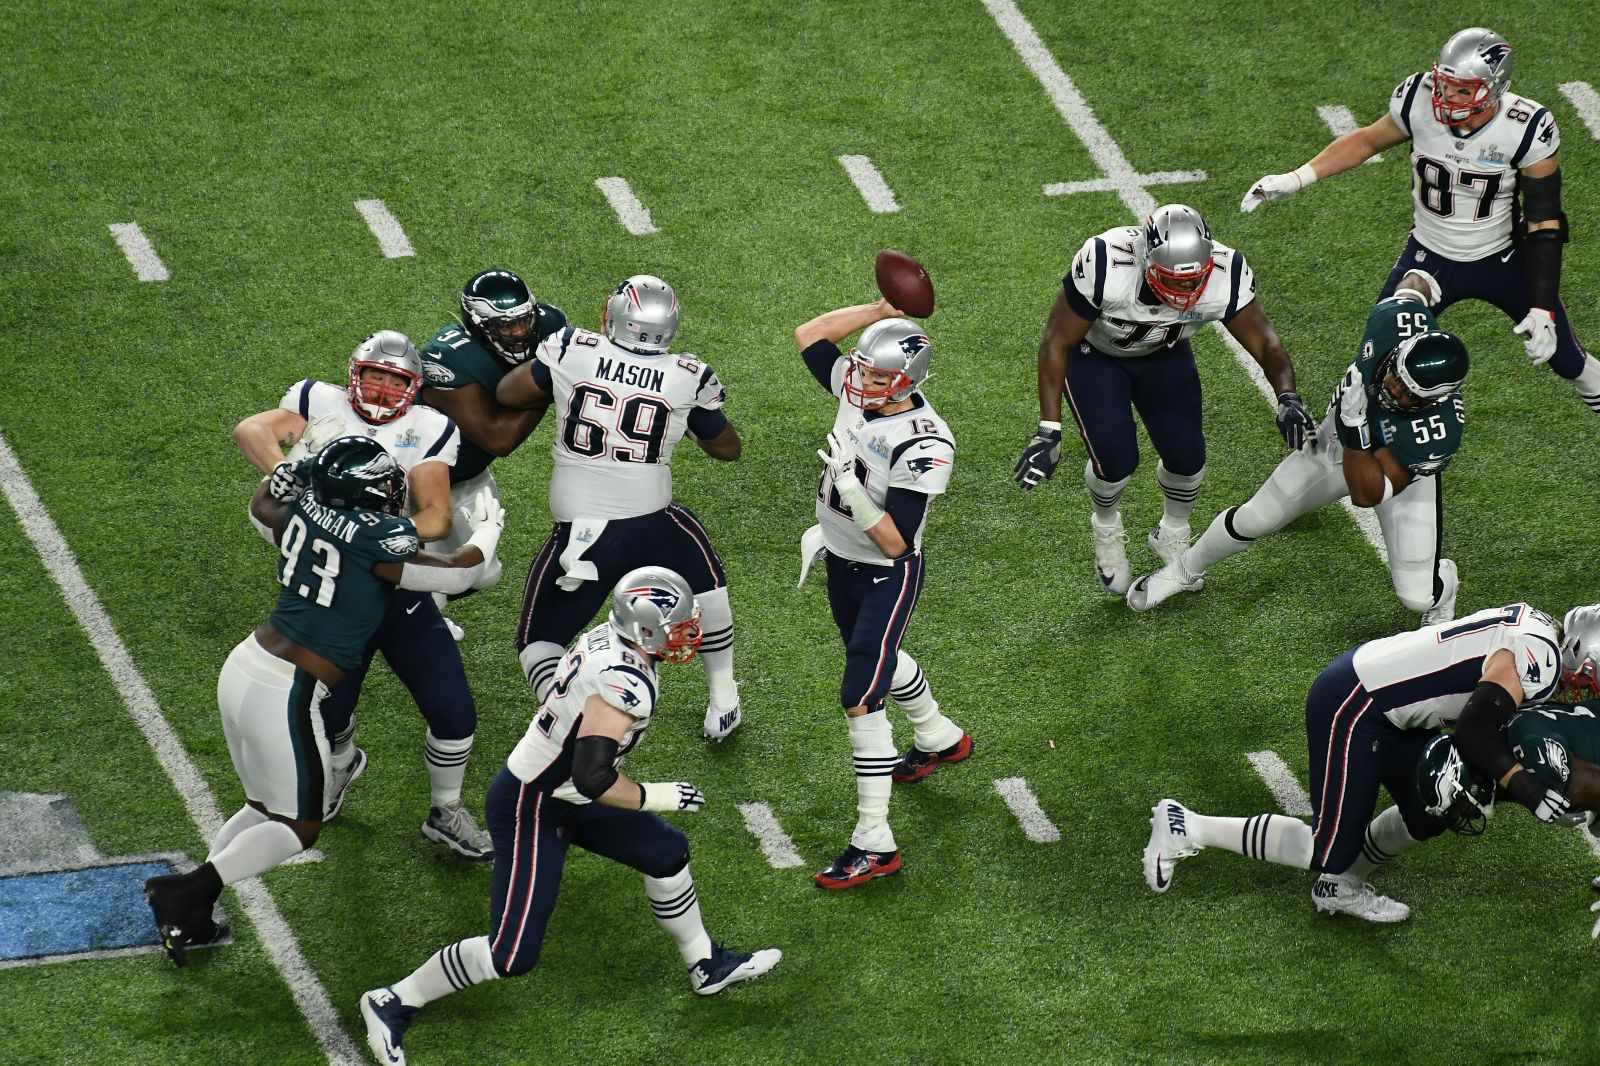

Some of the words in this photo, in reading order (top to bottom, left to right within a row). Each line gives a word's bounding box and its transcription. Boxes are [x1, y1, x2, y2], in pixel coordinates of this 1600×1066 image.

[1506, 98, 1536, 124] 87
[1416, 154, 1505, 222] 87
[1110, 241, 1136, 269] 71
[1396, 312, 1429, 338] 55
[595, 356, 665, 393] MASON
[561, 381, 673, 464] 69
[908, 418, 940, 436] 12
[1411, 414, 1447, 445] 55
[277, 514, 341, 608] 93
[1167, 803, 1187, 837] NIKE
[1312, 879, 1339, 898] NIKE
